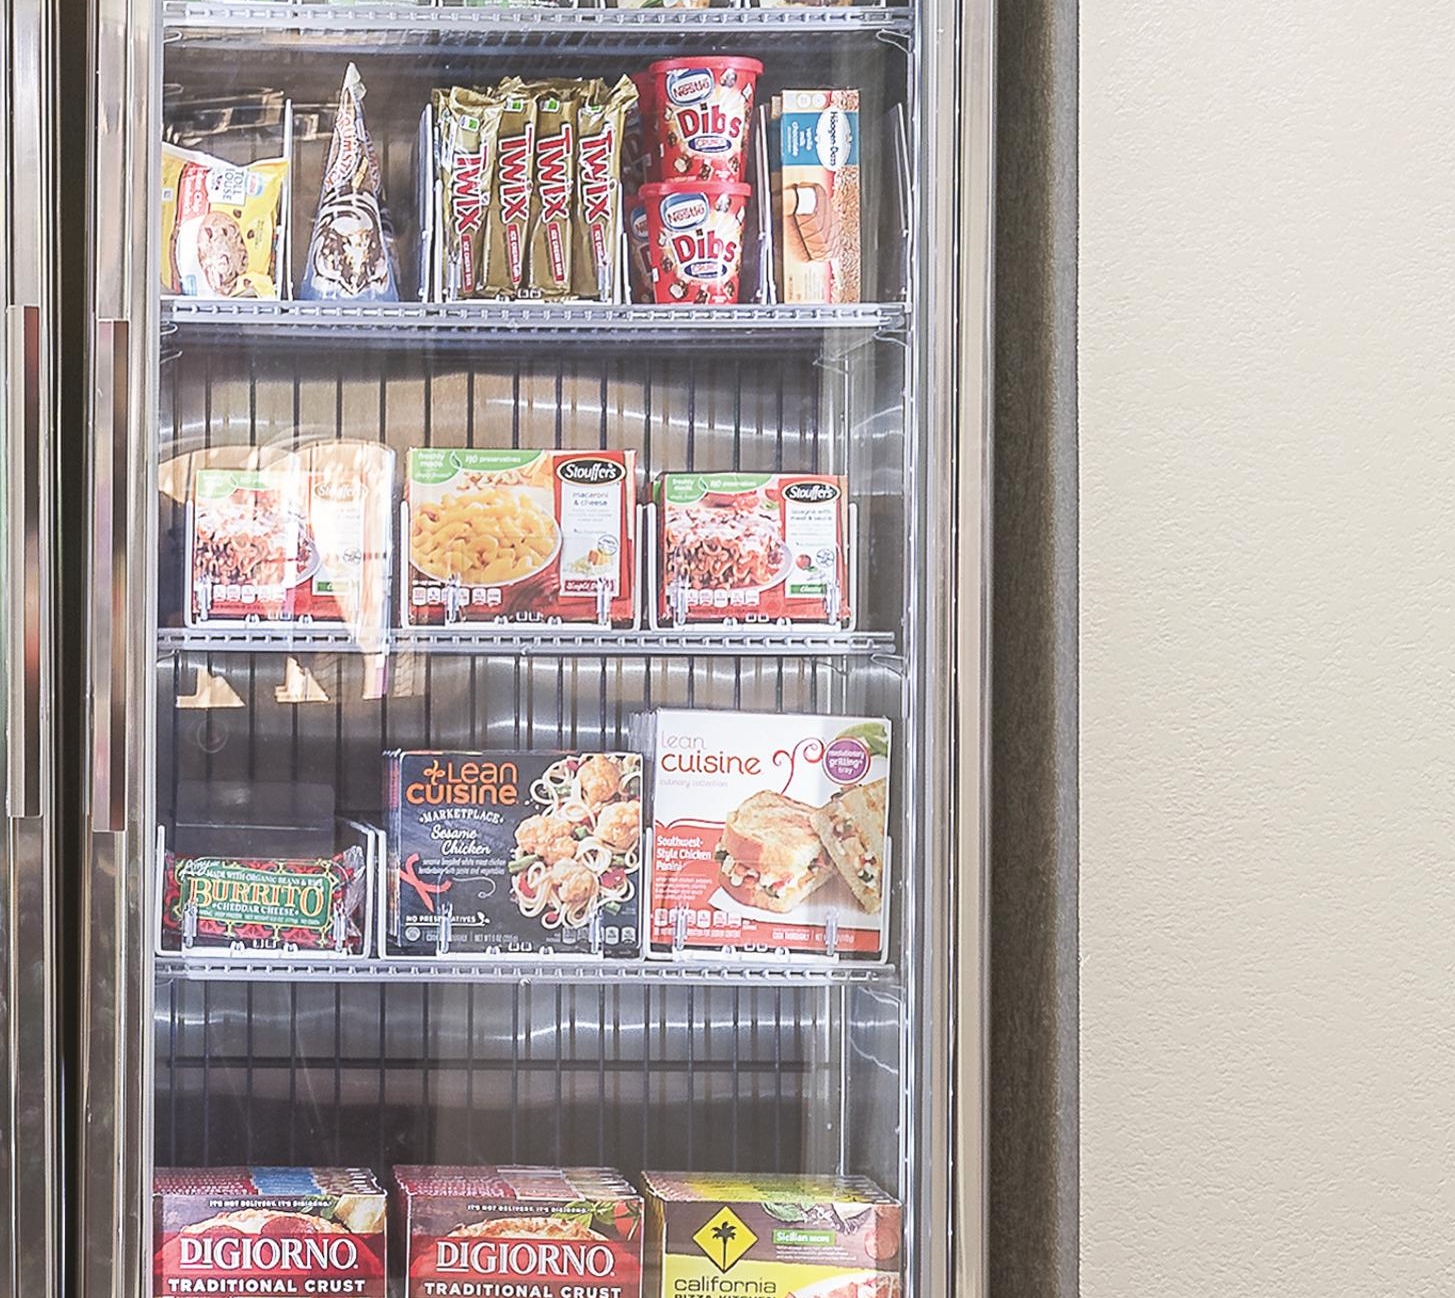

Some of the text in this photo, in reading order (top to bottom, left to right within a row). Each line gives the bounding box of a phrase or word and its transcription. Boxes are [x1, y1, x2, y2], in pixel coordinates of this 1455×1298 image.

[676, 106, 740, 142] Dibs
[498, 123, 533, 223] TWIX
[536, 123, 571, 223] TWIX
[580, 122, 615, 223] TWIX
[452, 146, 489, 234] TWIX
[671, 231, 737, 263] Dibs
[564, 462, 617, 482] Stouffer's
[787, 484, 836, 502] Stouffer's
[660, 731, 706, 750] lean
[660, 750, 762, 776] cuisine
[423, 809, 500, 824] MARKETPLACE
[431, 824, 478, 841] Sesame
[442, 840, 491, 856] Chicken
[657, 849, 712, 861] Style Chicken
[188, 878, 325, 917] BURRITO
[217, 904, 295, 916] CHEDDAR CHEESE
[168, 1279, 366, 1294] TRADITIONAL CRUST
[425, 1282, 553, 1298] TRADITIONAL
[674, 1276, 776, 1295] california
